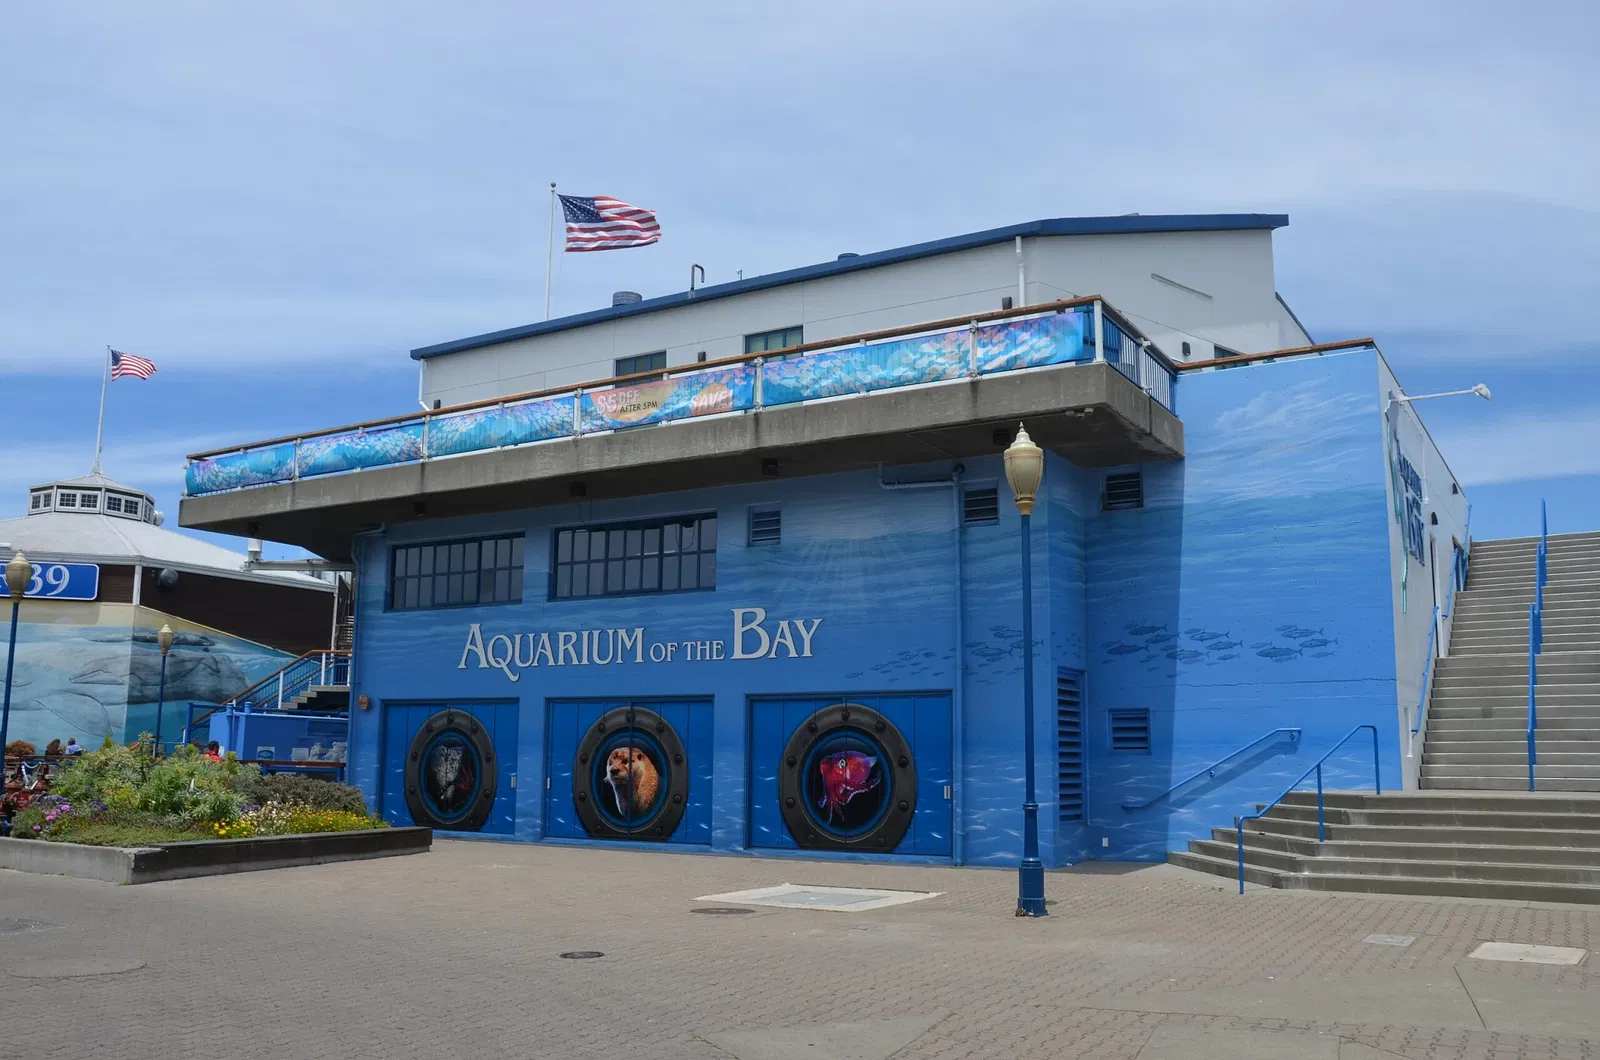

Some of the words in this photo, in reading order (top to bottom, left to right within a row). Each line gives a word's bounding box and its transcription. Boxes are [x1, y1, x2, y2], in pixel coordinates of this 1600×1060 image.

[597, 393, 618, 415] $5
[619, 389, 640, 405] OFF
[620, 403, 641, 413] AFTER
[643, 400, 658, 410] 5PM
[24, 563, 70, 596] 39
[457, 623, 646, 682] AQUARIUM
[649, 642, 678, 663] OF
[683, 640, 725, 661] THE
[730, 607, 824, 660] BAY
